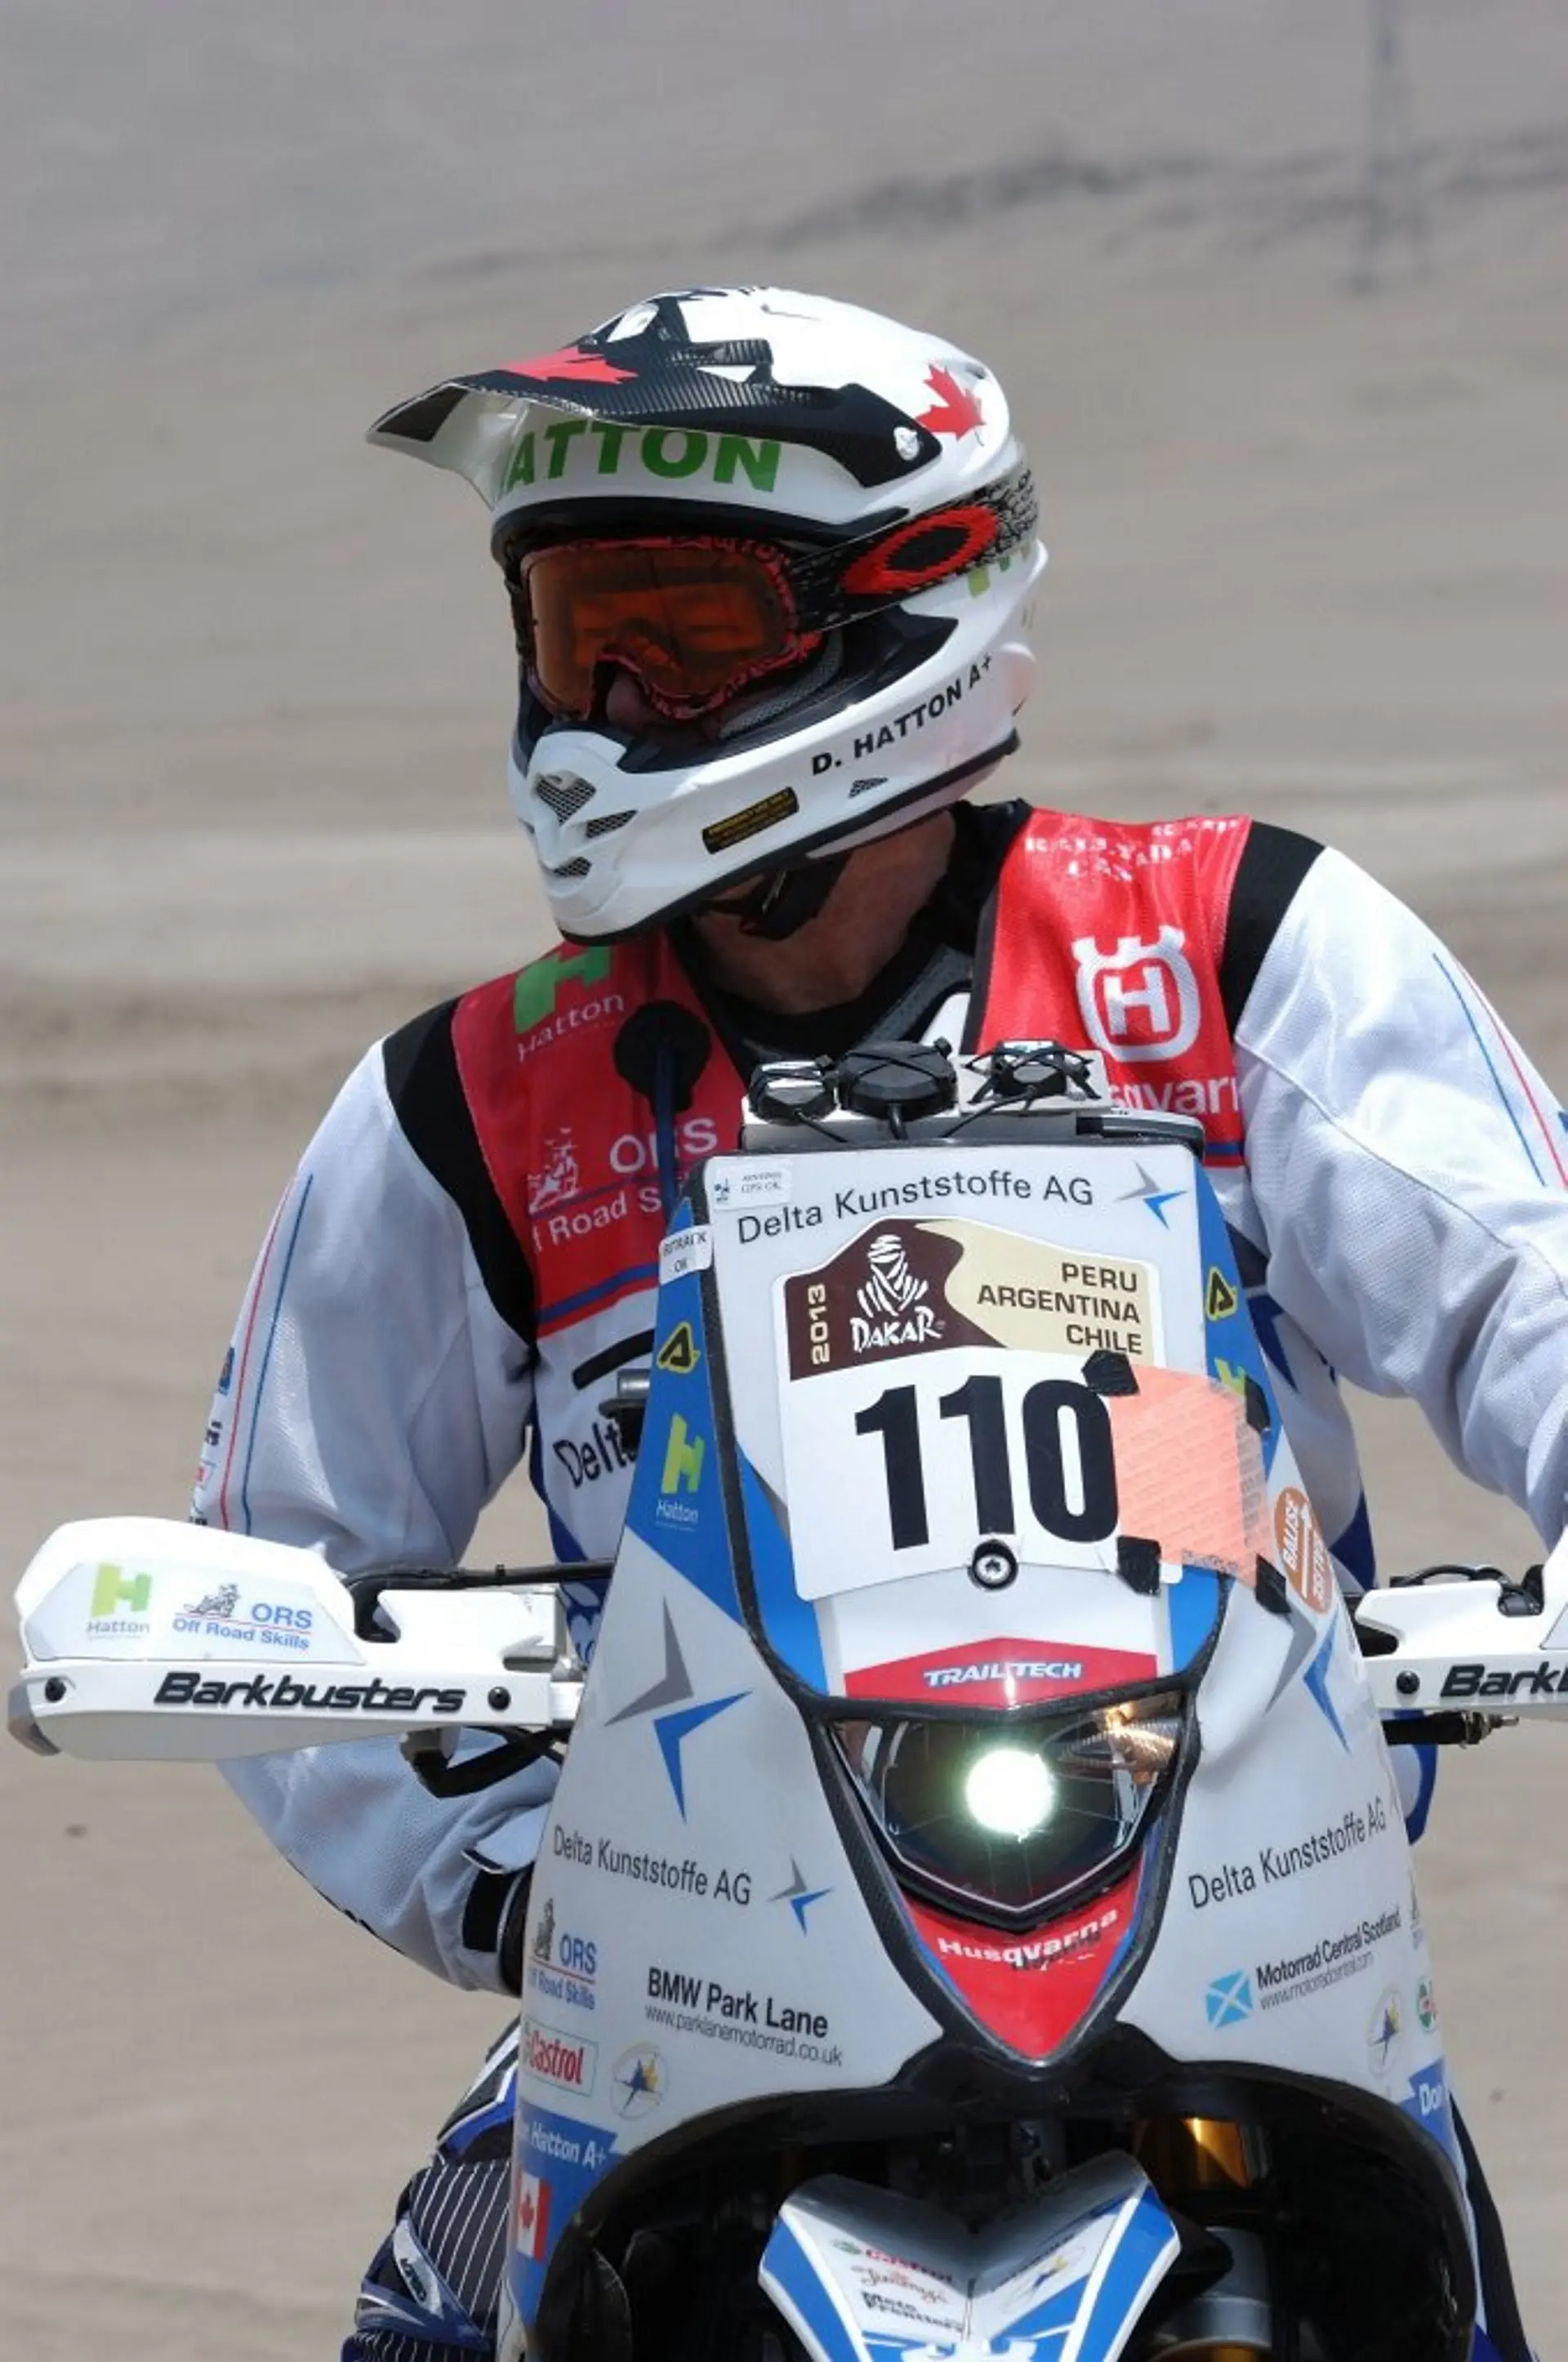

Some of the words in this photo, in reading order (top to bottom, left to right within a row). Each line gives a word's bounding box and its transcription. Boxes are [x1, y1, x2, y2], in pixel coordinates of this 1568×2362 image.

[500, 418, 782, 493] ATTON
[812, 751, 842, 776] D.
[853, 679, 963, 759] HATTON
[549, 1190, 628, 1246] Road
[737, 1206, 824, 1245] Delta
[835, 1170, 1032, 1220] Kunststoffe
[1044, 1175, 1094, 1206] AG
[977, 1285, 1142, 1324] ARGENTINA
[1061, 1263, 1138, 1293] PERU
[808, 1284, 830, 1365] 2013
[1066, 1323, 1143, 1355] CHILE
[854, 1375, 1120, 1551] 110
[86, 1620, 150, 1633] Hatton
[172, 1617, 201, 1633] Off
[206, 1621, 256, 1641] Road
[261, 1629, 310, 1651] Skills
[251, 1602, 313, 1629] ORS
[153, 1671, 468, 1714] Barkbusters
[554, 1824, 593, 1865] Delta
[598, 1836, 708, 1896] Kunststoffe
[713, 1868, 752, 1907] AG
[1188, 1863, 1257, 1910] Delta
[1258, 1810, 1365, 1884] Kunststoffe
[1367, 1794, 1387, 1837] AG
[559, 1932, 598, 1976] ORS
[937, 1909, 1119, 1968] Husqvarna
[1255, 1943, 1321, 1991] Motorrad
[1321, 1924, 1363, 1963] Central
[647, 1966, 703, 2009] BMW
[706, 1981, 759, 2025] Park
[765, 1997, 829, 2039] Lane
[529, 2029, 586, 2086] Castrol
[531, 2121, 581, 2164] Hatton
